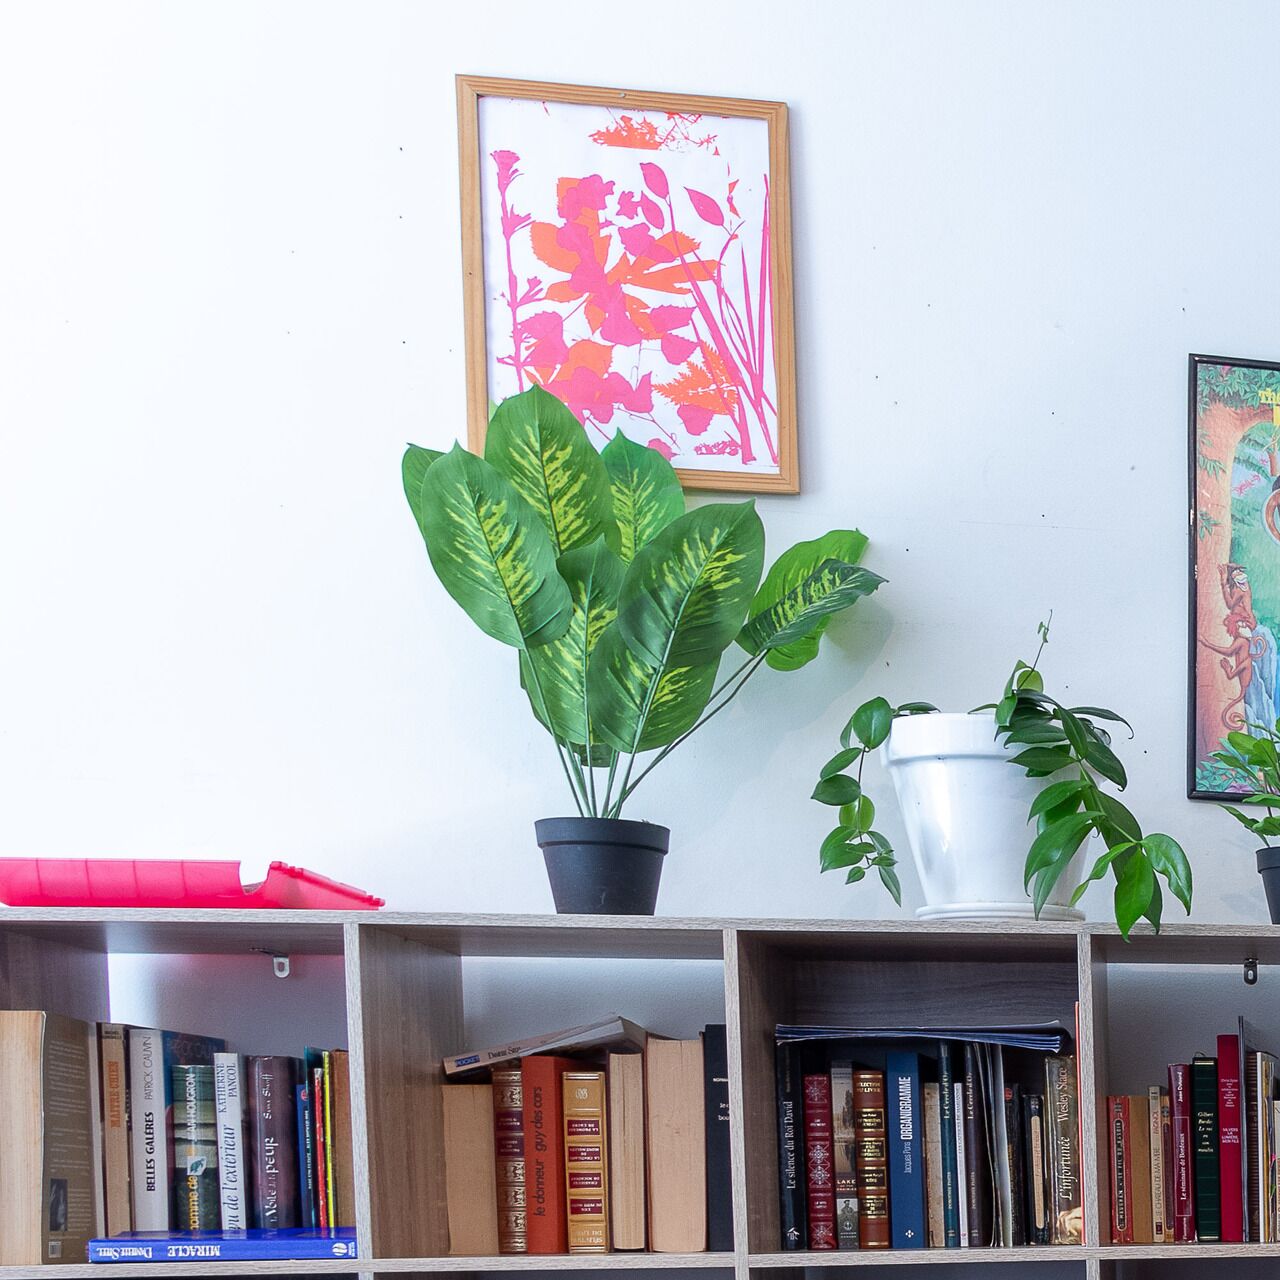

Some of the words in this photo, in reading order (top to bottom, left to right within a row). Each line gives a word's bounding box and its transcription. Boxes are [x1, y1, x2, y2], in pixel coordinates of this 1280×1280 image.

[143, 1036, 152, 1068] CAUVIN
[144, 1071, 153, 1100] PATRICK
[216, 1063, 227, 1113] KATHERINE
[226, 1063, 237, 1098] PANCOL
[1056, 1067, 1068, 1090] Stace
[186, 1074, 197, 1119] HOUGRON
[534, 1086, 542, 1110] cars
[899, 1077, 913, 1140] ORGANIGRAMME
[1057, 1092, 1072, 1121] Wesley
[534, 1112, 544, 1129] des
[783, 1101, 793, 1123] David
[535, 1130, 547, 1152] guy
[784, 1125, 794, 1138] Roi
[220, 1124, 238, 1191] l'extérieur
[784, 1140, 794, 1151] du
[146, 1158, 156, 1192] BELLES
[784, 1152, 795, 1178] silence
[1057, 1136, 1077, 1200] L'infortunée
[187, 1175, 199, 1189] de
[534, 1159, 545, 1200] donneur
[786, 1179, 796, 1189] Le
[222, 1193, 239, 1211] de
[533, 1203, 545, 1217] le
[168, 1245, 220, 1257] MIRACLE
